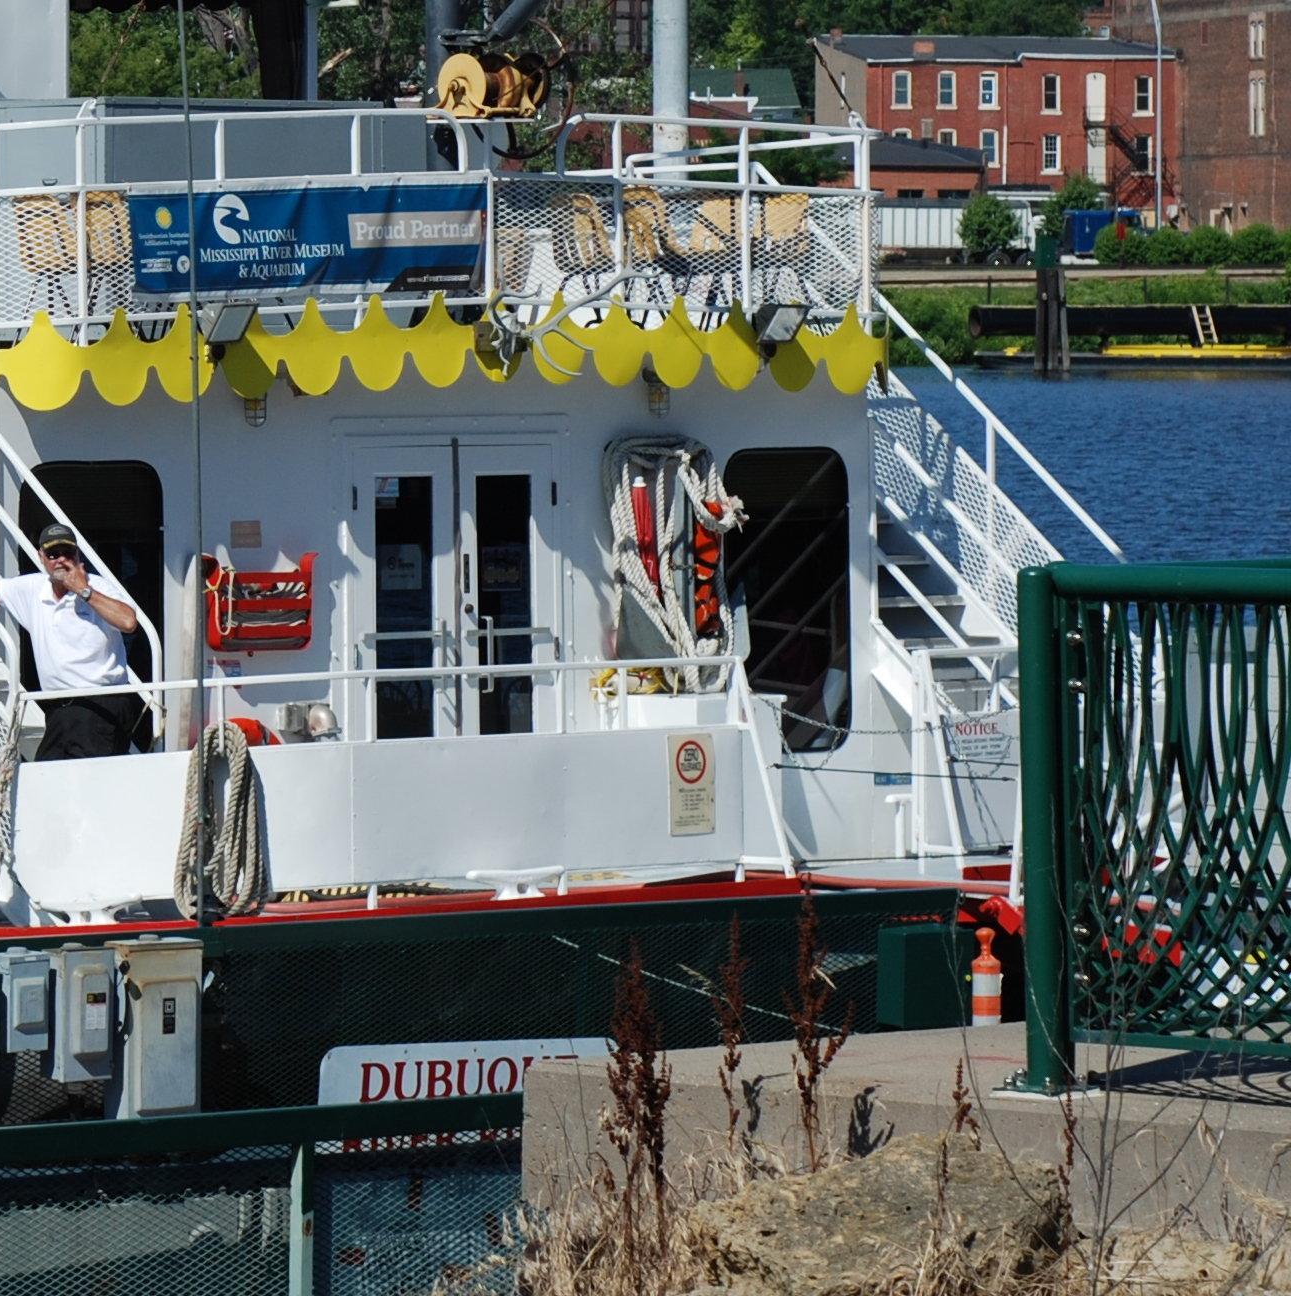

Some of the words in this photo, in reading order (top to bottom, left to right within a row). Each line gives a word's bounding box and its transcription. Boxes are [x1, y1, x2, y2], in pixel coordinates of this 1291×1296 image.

[242, 228, 298, 244] NATIONAL
[355, 220, 406, 241] Proud
[410, 219, 477, 240] Partner
[199, 247, 260, 263] MISSISSIPPI
[262, 245, 292, 261] RIVER
[294, 243, 345, 259] MUSEUM
[239, 264, 248, 278] &
[250, 262, 306, 280] AQUARIUM
[955, 722, 999, 736] NOTICE
[684, 748, 699, 761] ZERO
[359, 1055, 578, 1103] DUBUQ
